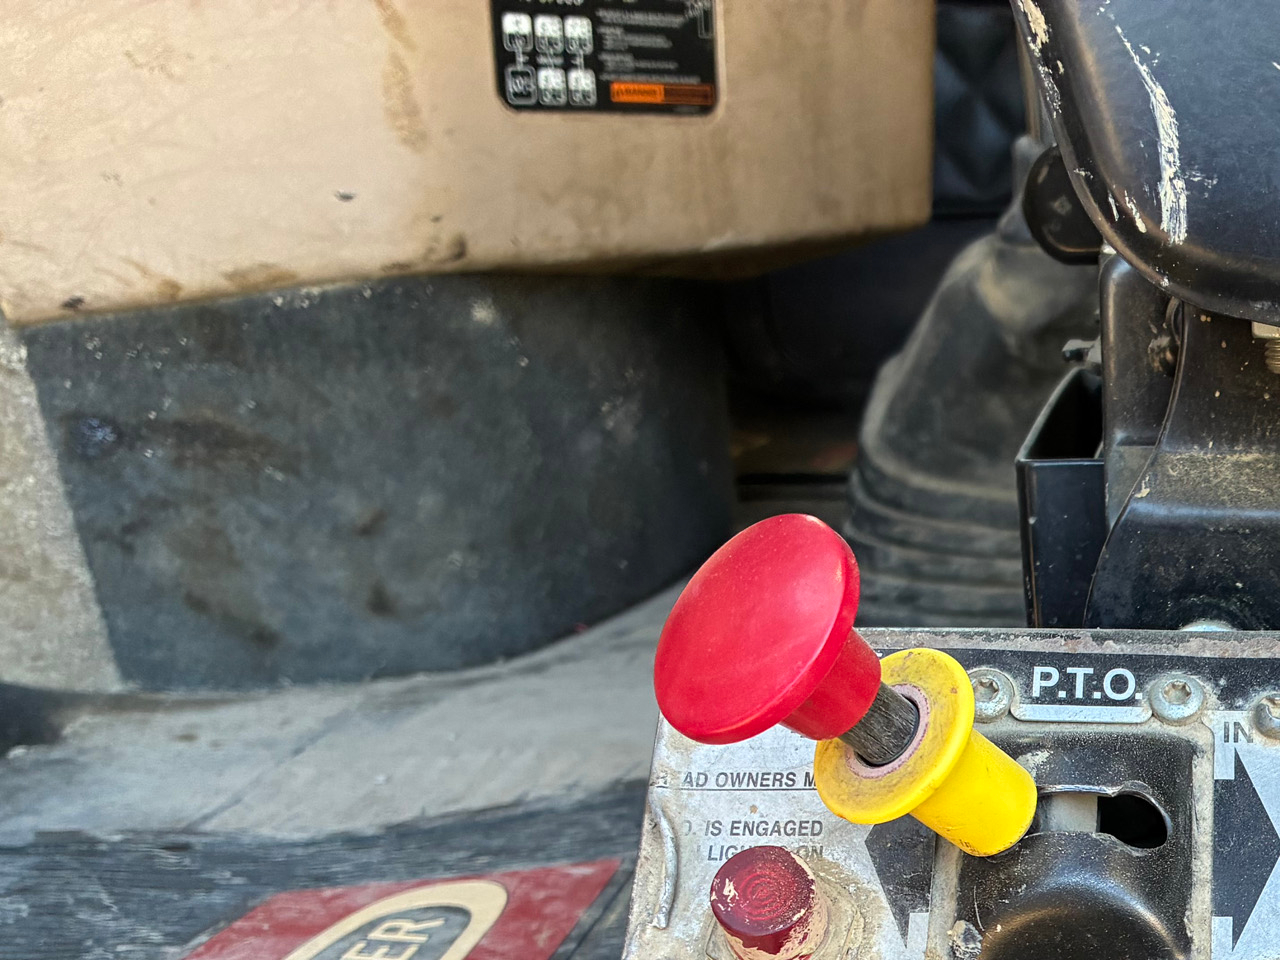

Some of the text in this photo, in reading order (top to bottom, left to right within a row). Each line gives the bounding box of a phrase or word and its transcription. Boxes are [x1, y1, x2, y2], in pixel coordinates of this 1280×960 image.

[1032, 666, 1143, 700] P.T.O.
[1223, 721, 1254, 744] IN
[715, 771, 797, 788] OWNERS
[704, 819, 723, 837] IS
[729, 819, 824, 837] ENGAGED
